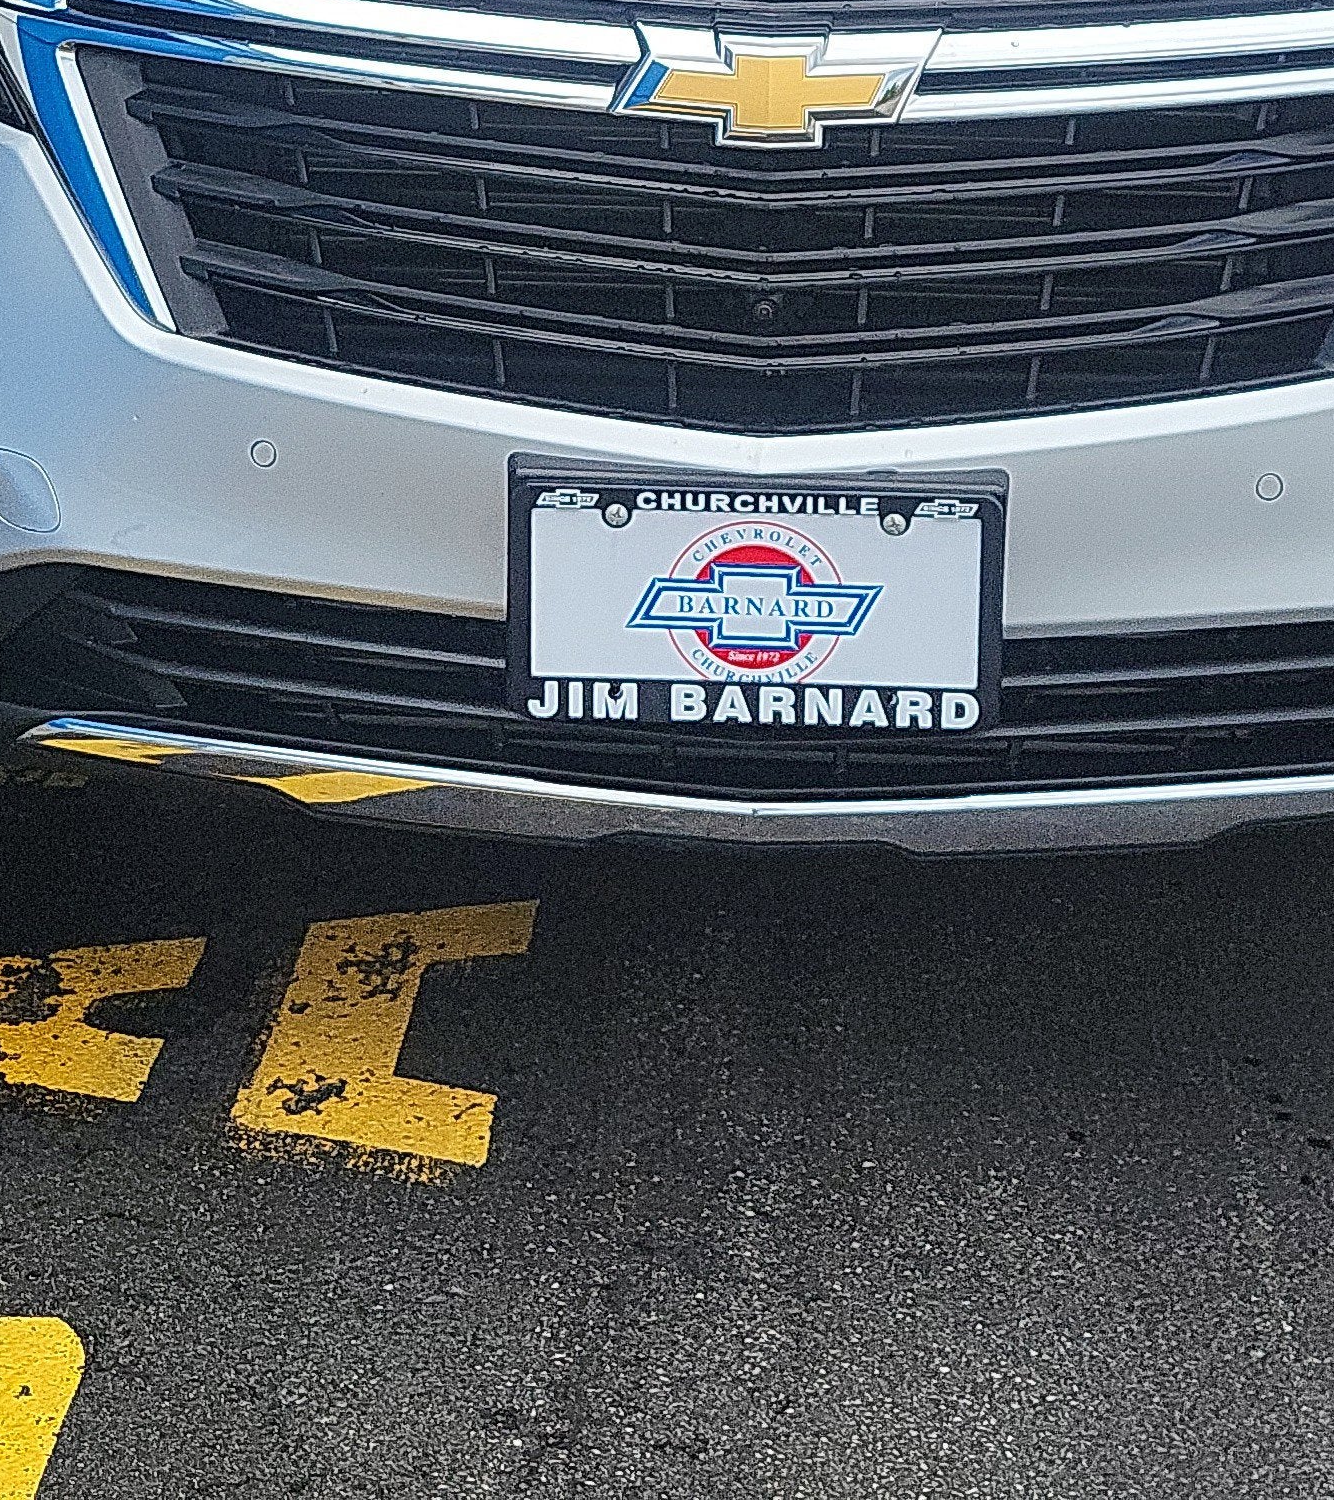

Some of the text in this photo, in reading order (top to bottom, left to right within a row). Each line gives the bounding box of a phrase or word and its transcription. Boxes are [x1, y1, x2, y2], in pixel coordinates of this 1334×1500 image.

[636, 491, 880, 516] CHURCHVILLE
[692, 528, 823, 567] CHEVROLET
[677, 594, 835, 618] BARNARD
[527, 679, 981, 731] JIM BARNARD
